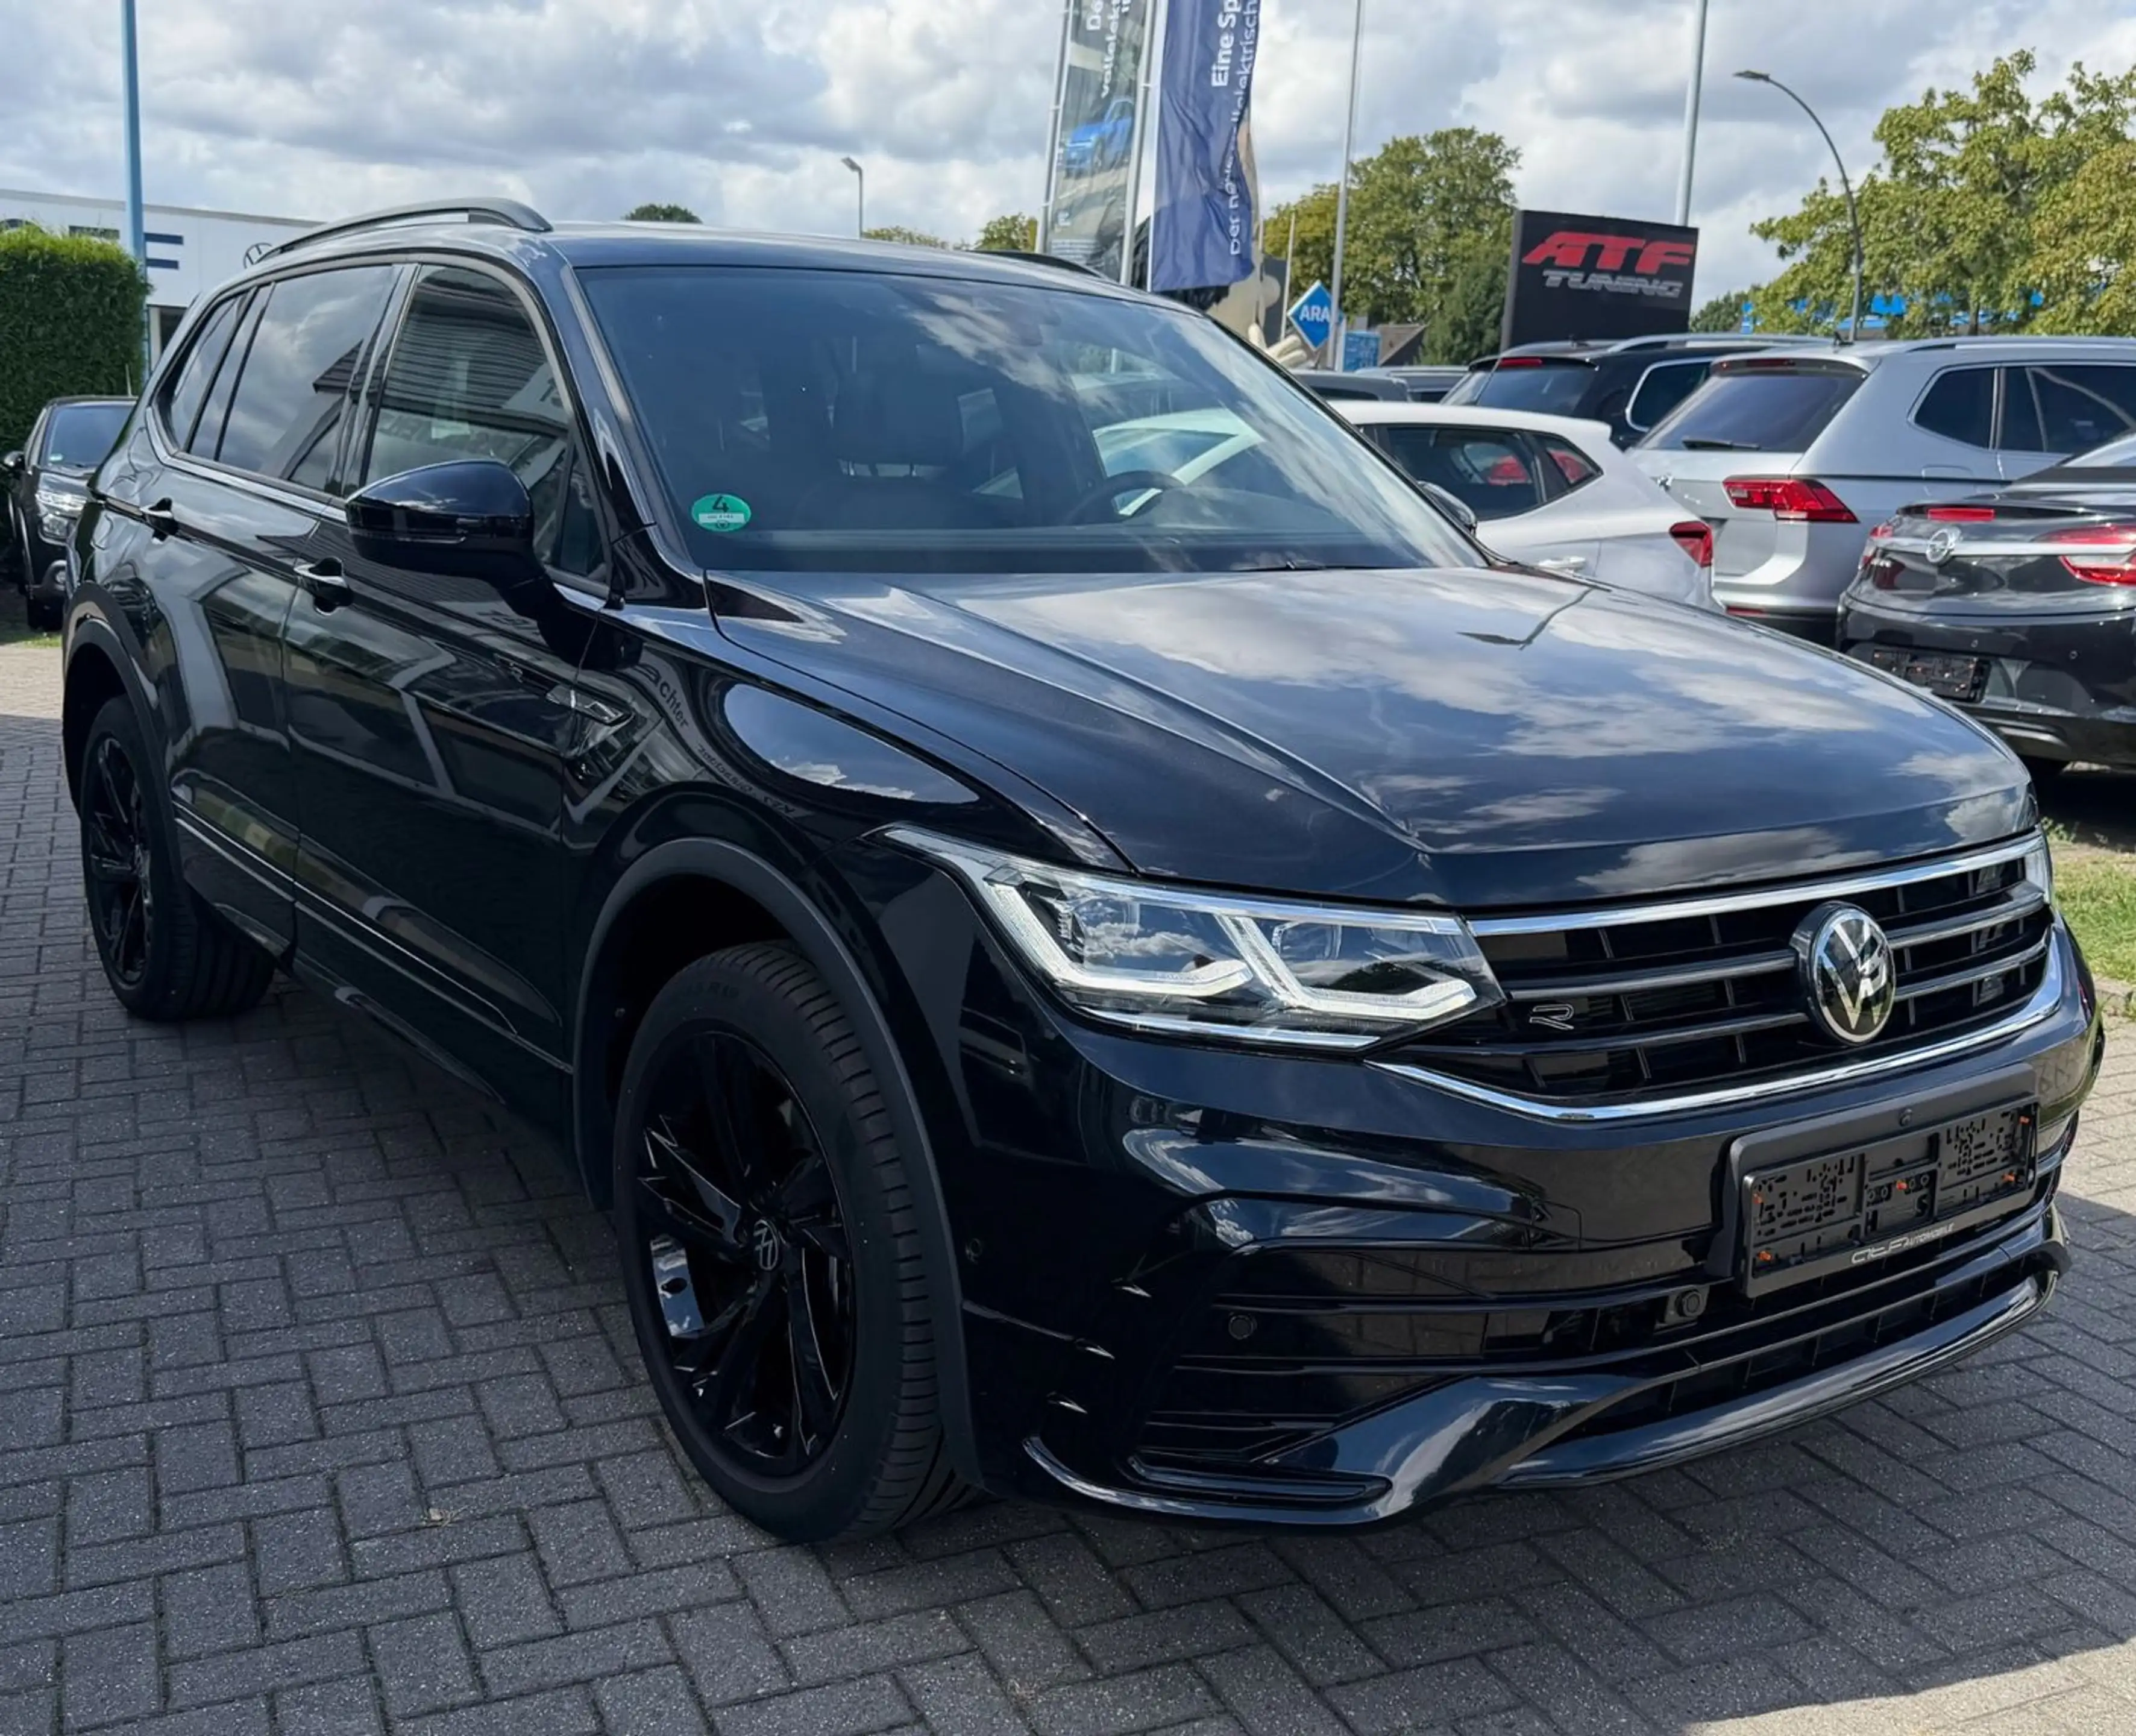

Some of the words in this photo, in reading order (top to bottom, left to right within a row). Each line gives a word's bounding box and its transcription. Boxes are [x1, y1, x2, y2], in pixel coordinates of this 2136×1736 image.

[1211, 32, 1234, 86] Eine
[1522, 231, 1694, 274] ATF
[1542, 269, 1683, 298] TUNING
[1299, 304, 1331, 323] ARA
[712, 495, 730, 512] 4
